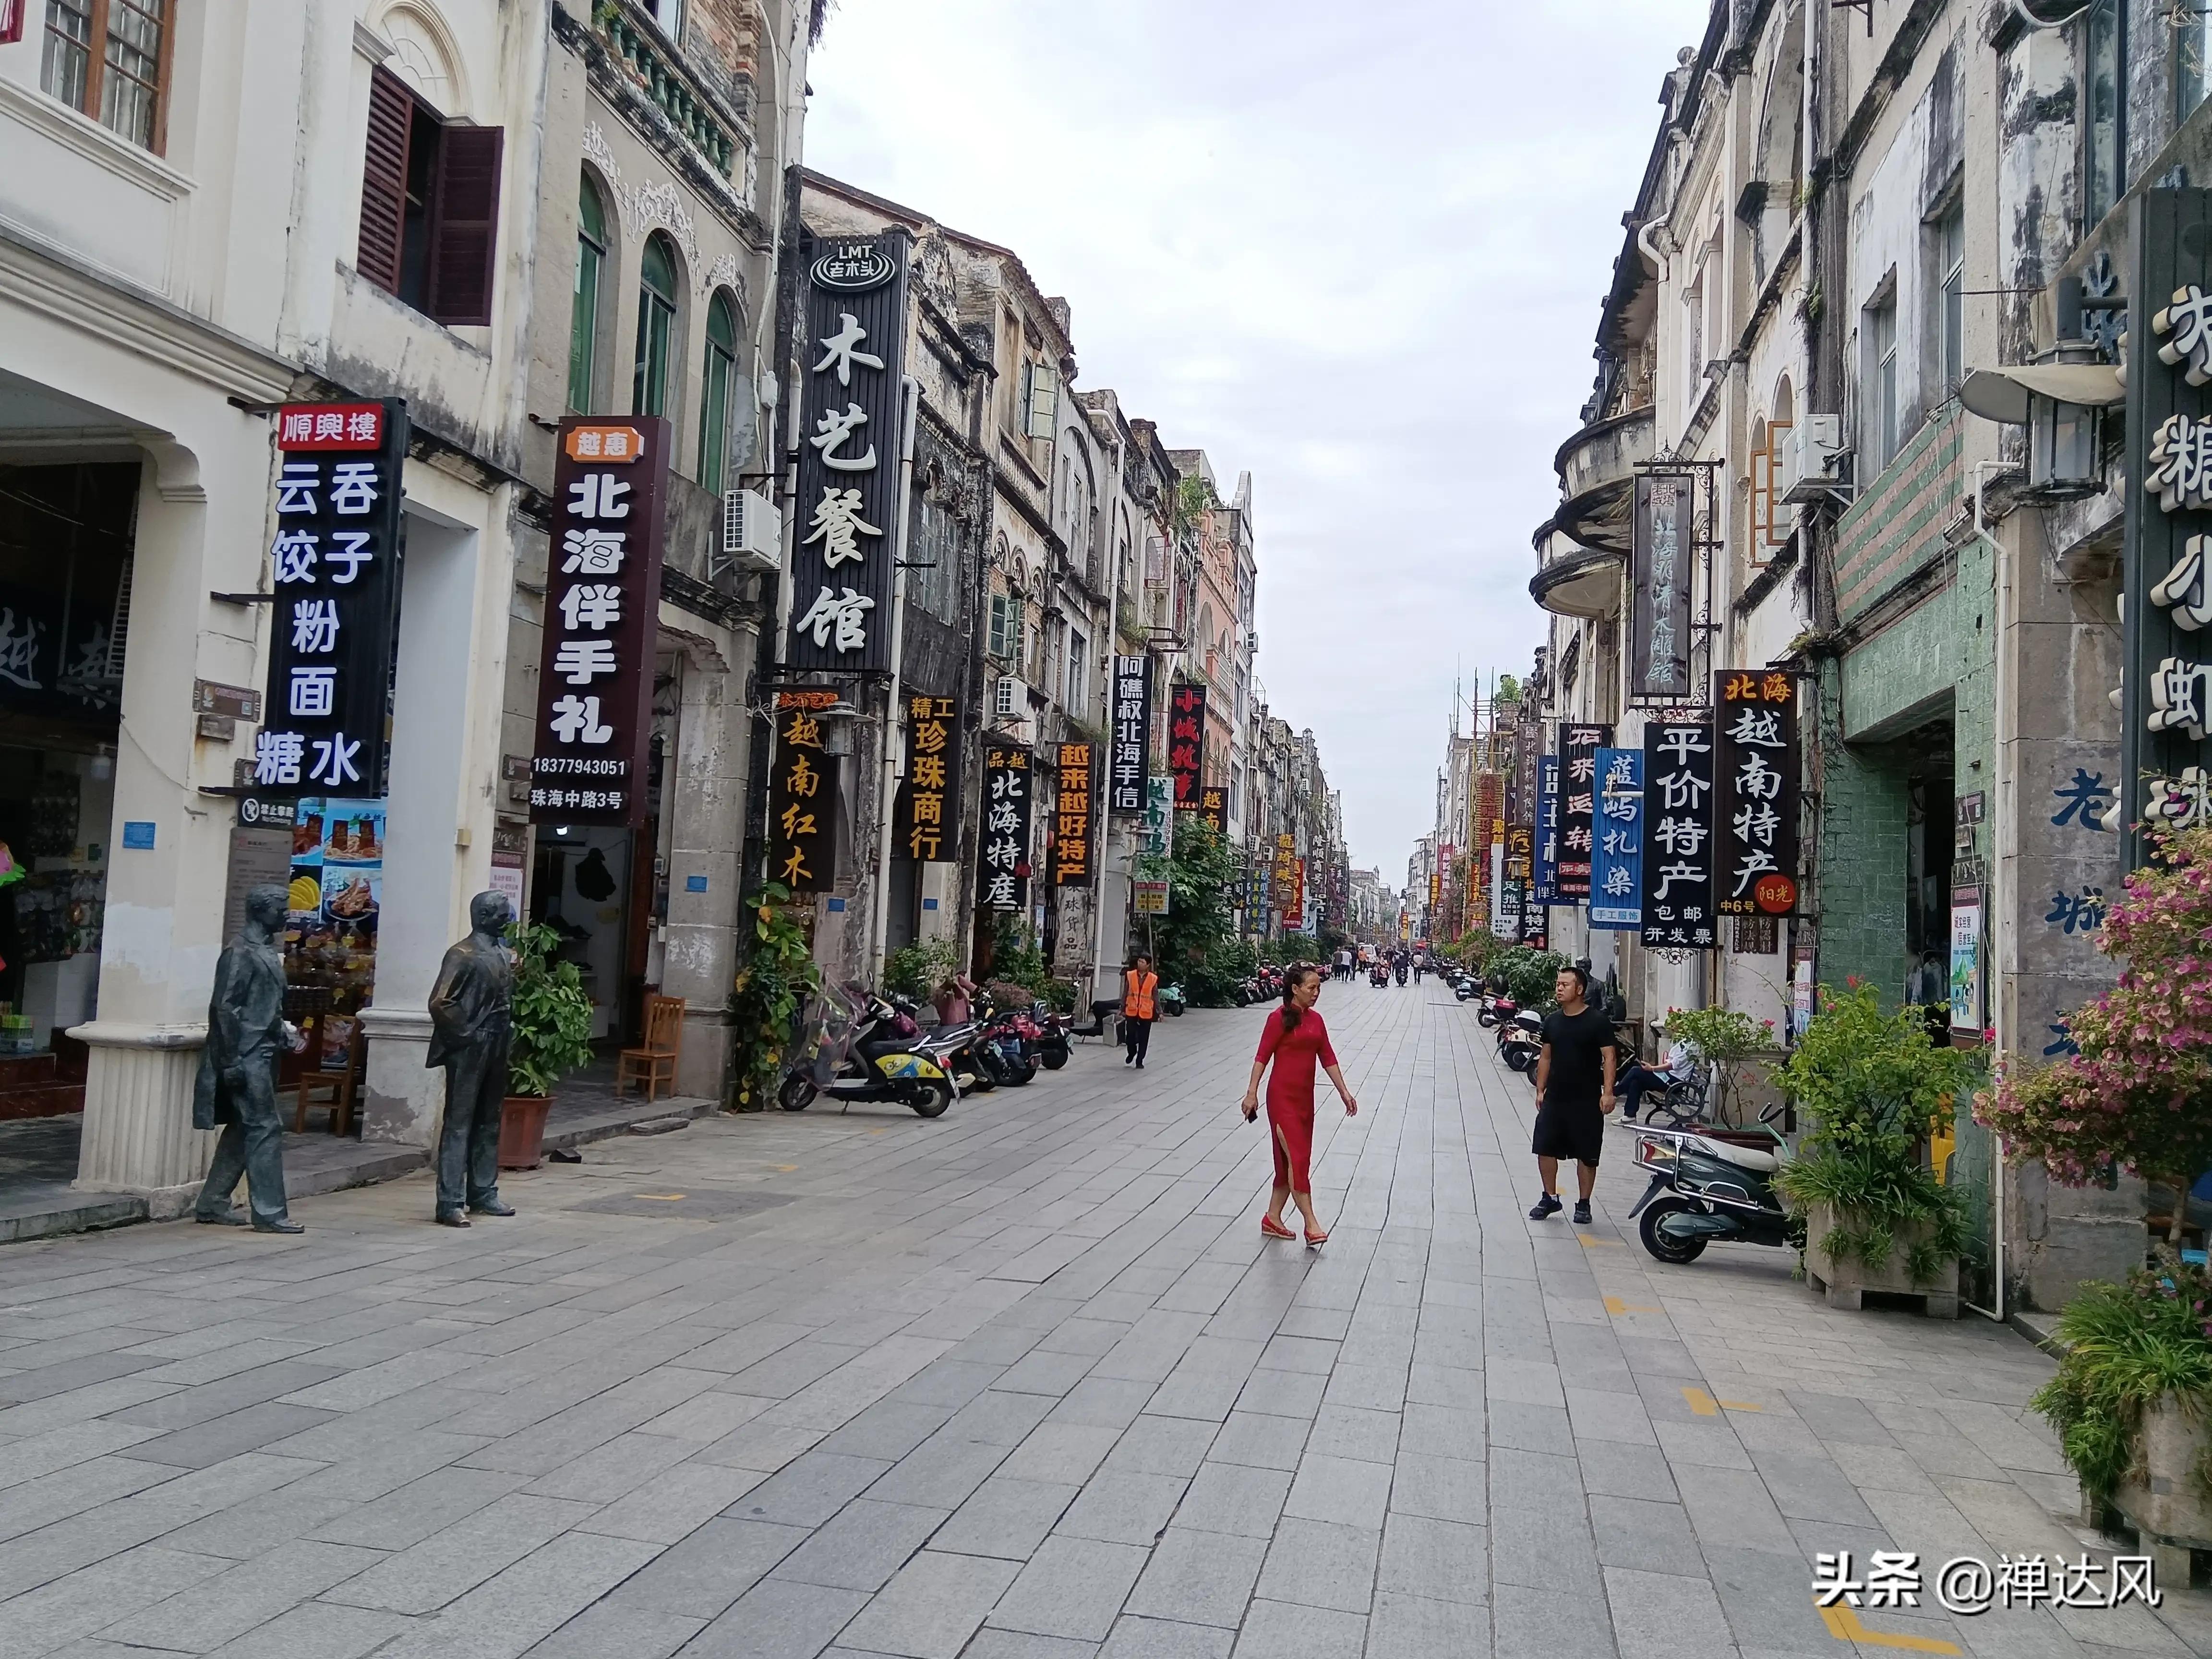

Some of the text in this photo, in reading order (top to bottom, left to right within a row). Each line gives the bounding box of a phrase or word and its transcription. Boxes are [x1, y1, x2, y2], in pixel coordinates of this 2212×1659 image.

[830, 260, 876, 277] 老木头
[839, 245, 873, 259] LMT
[282, 411, 377, 442] 順興樓
[577, 431, 627, 457] 越惠
[274, 462, 378, 516] 云吞
[796, 313, 884, 654] 木艺餐馆
[270, 530, 373, 585] 饺子
[292, 598, 339, 654] 粉
[549, 473, 631, 744] 北海伴手礼
[289, 666, 337, 716] 面
[912, 698, 955, 719] 精工
[1724, 673, 1792, 703] 北海
[254, 731, 361, 786] 糖水
[1114, 656, 1145, 808] 阿礁叔北海手信
[1171, 688, 1202, 800] 小城故事
[533, 757, 625, 775] 18377943051
[910, 720, 948, 859] 珍珠商行
[1564, 729, 1601, 853] 石来运转
[530, 789, 623, 809] 珠海中路3号
[781, 712, 824, 887] 越南红木
[1057, 744, 1089, 884] 越来越好特产
[1601, 754, 1638, 897] 蓝屿扎染
[1654, 727, 1711, 901] 平价特产
[1725, 707, 1787, 898] 越南特产
[983, 769, 1023, 905] 北海特產
[1563, 884, 1591, 892] 珠海中路
[1596, 909, 1639, 921] 手工服饰
[1655, 904, 1703, 922] 包邮
[1720, 900, 1755, 913] 中6号
[1759, 885, 1793, 903] 阳光
[1645, 927, 1713, 945] 开发票
